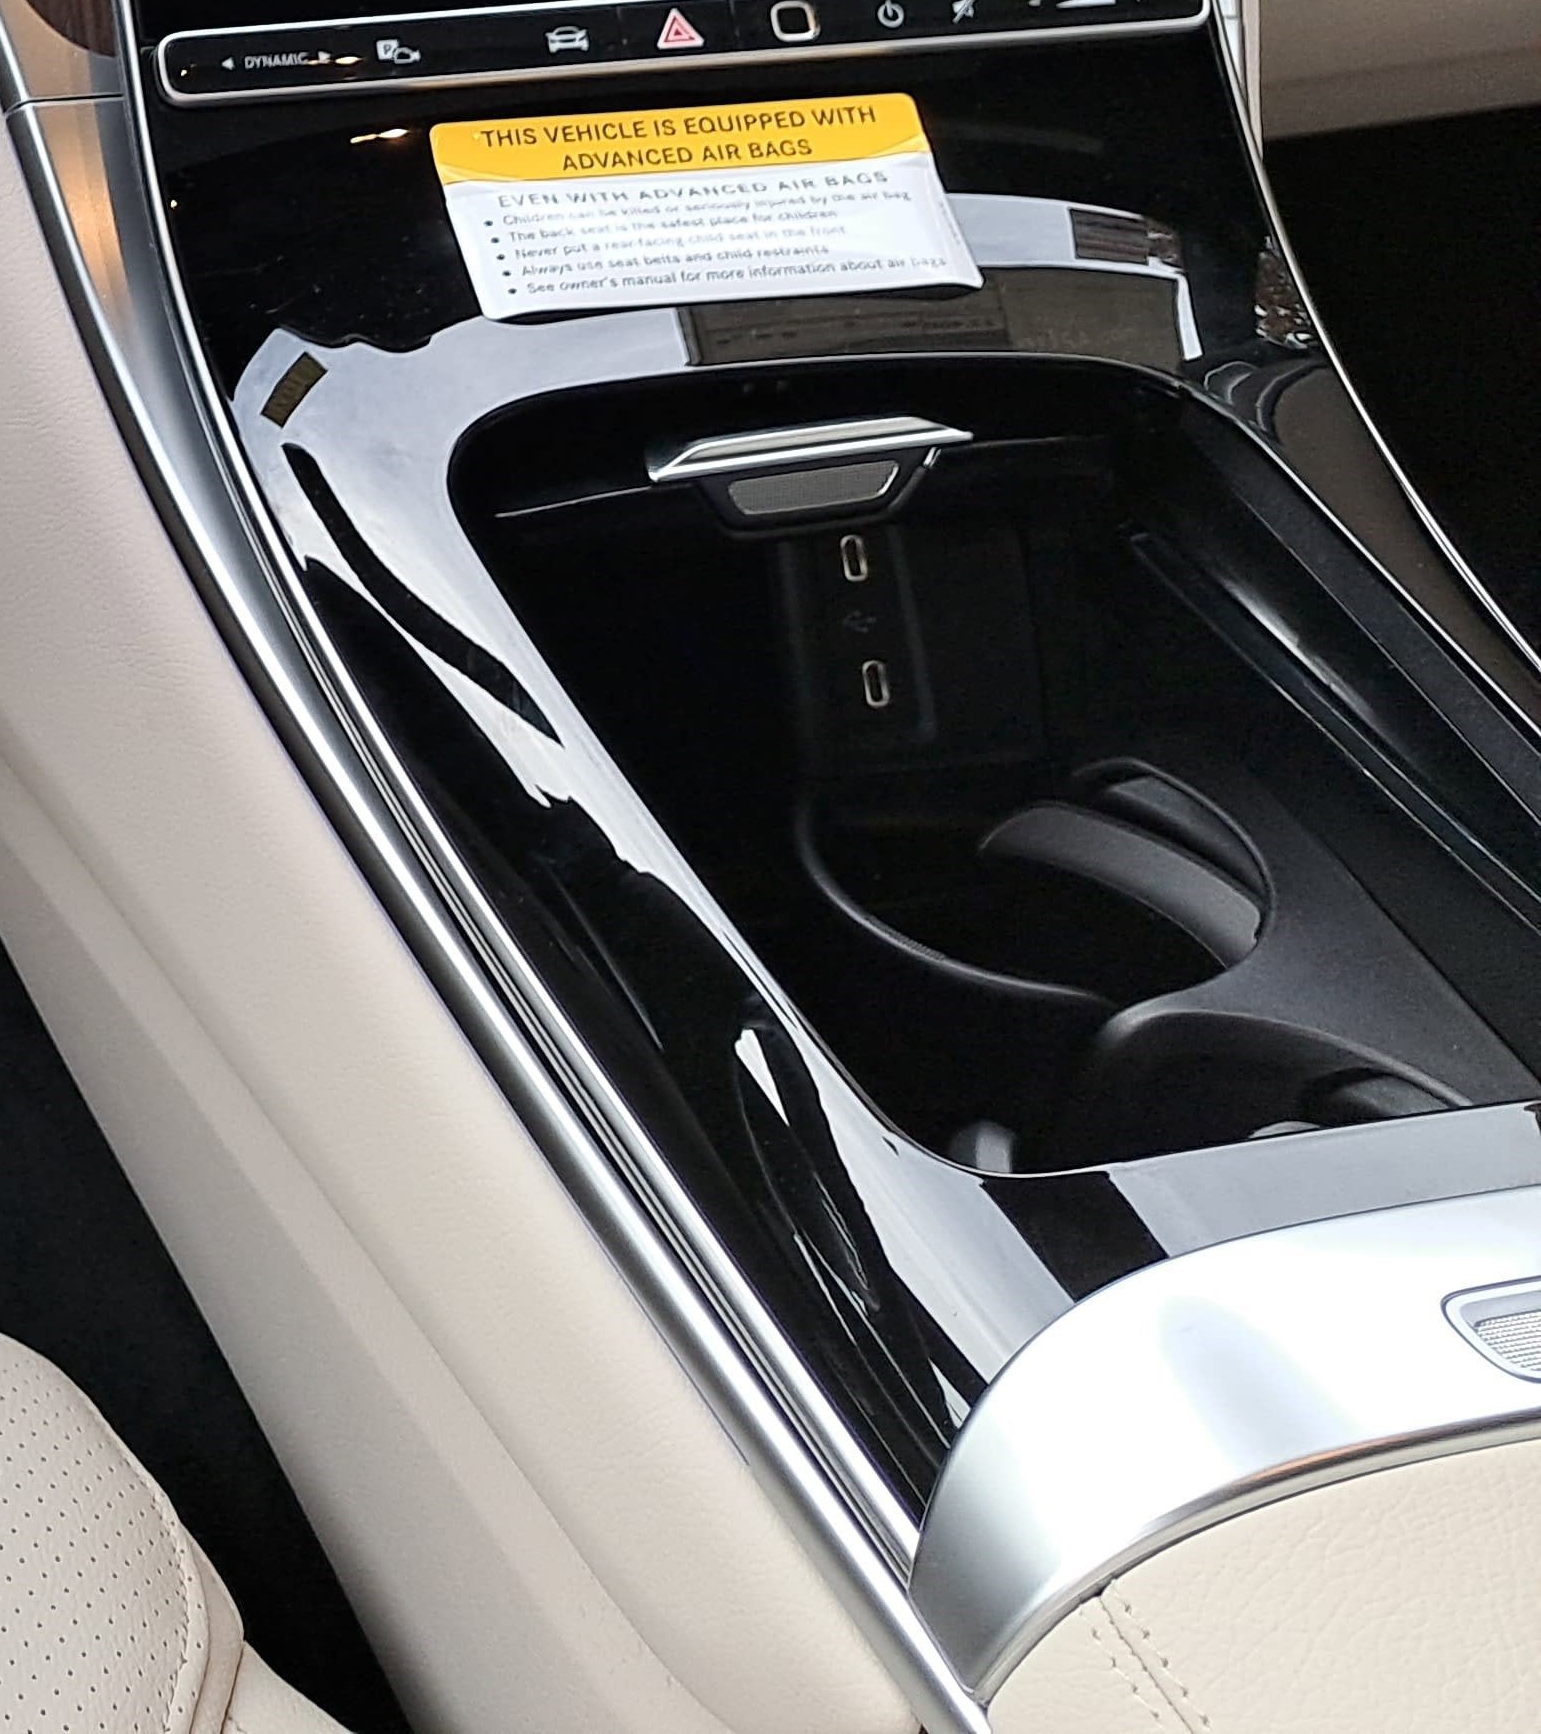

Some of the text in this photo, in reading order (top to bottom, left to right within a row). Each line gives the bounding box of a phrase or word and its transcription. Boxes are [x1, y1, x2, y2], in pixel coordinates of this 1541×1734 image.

[244, 51, 309, 70] DYNAMIC
[481, 105, 877, 147] THIS VEHICLE IS EQUIPPED WITH
[562, 138, 813, 171] ADVANCED AIR BAGS
[498, 171, 888, 208] EVEN WITH ADVANCED AIR BAGS
[509, 231, 535, 243] The
[526, 282, 555, 294] See
[559, 277, 618, 291] owner's
[622, 271, 677, 287] manual
[680, 269, 702, 282] for
[706, 267, 745, 281] more
[749, 260, 836, 279] information
[839, 257, 883, 272] about
[887, 255, 906, 268] air
